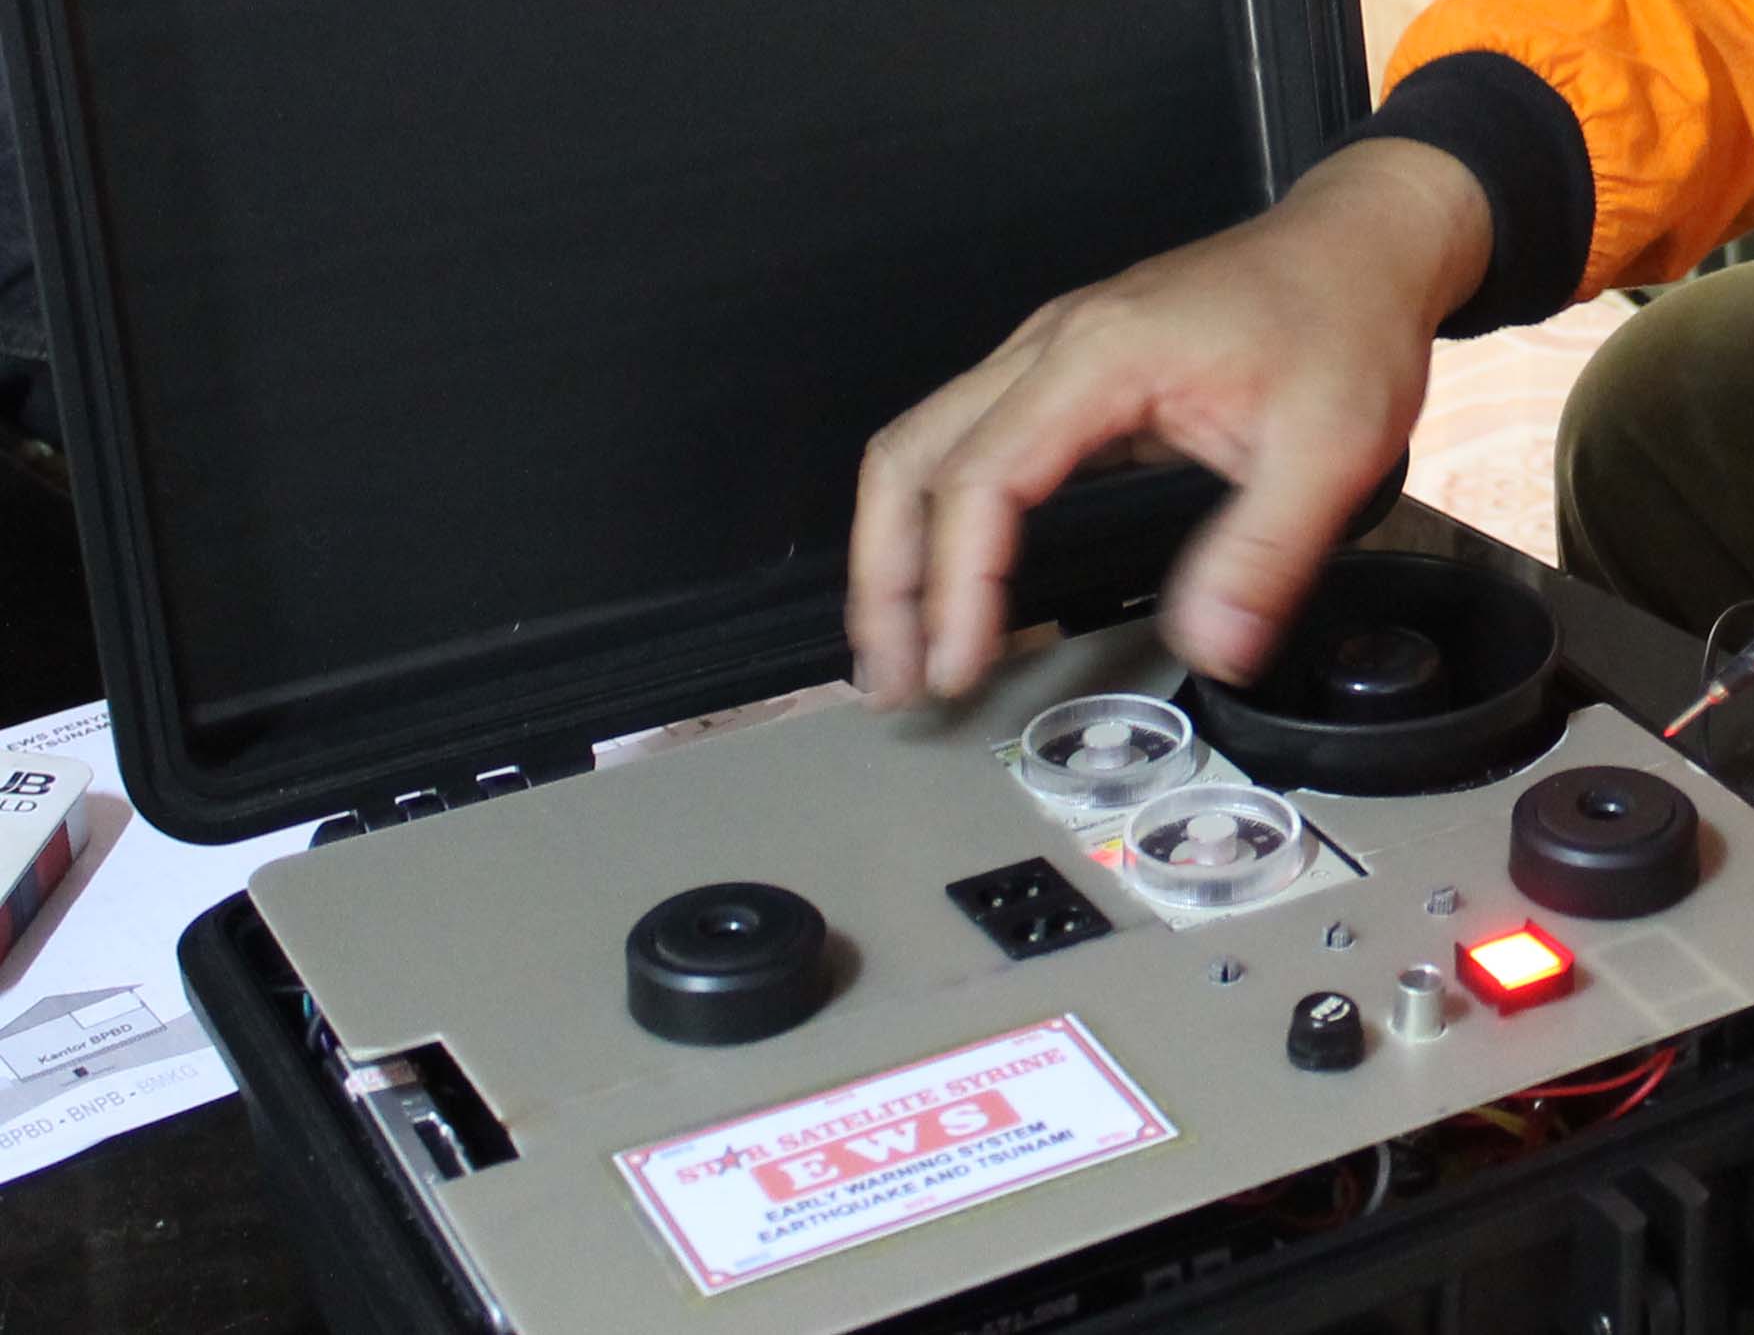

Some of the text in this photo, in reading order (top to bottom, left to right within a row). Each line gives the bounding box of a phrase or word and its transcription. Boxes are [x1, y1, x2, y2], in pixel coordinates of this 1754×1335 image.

[37, 1023, 133, 1065] Kantor BPBD
[0, 1118, 54, 1150] BPBD
[66, 1090, 125, 1122] BNPB
[776, 1088, 940, 1153] SATELITE
[944, 1047, 1067, 1098] SYRINE
[777, 1101, 991, 1191] EWS
[756, 1181, 919, 1245] EARTHQUAKE
[923, 1164, 971, 1190] AND
[976, 1128, 1075, 1170] TSUNAMI
[765, 1188, 839, 1223] EARLY
[845, 1152, 953, 1196] WARNING
[959, 1120, 1048, 1160] SYSTEM
